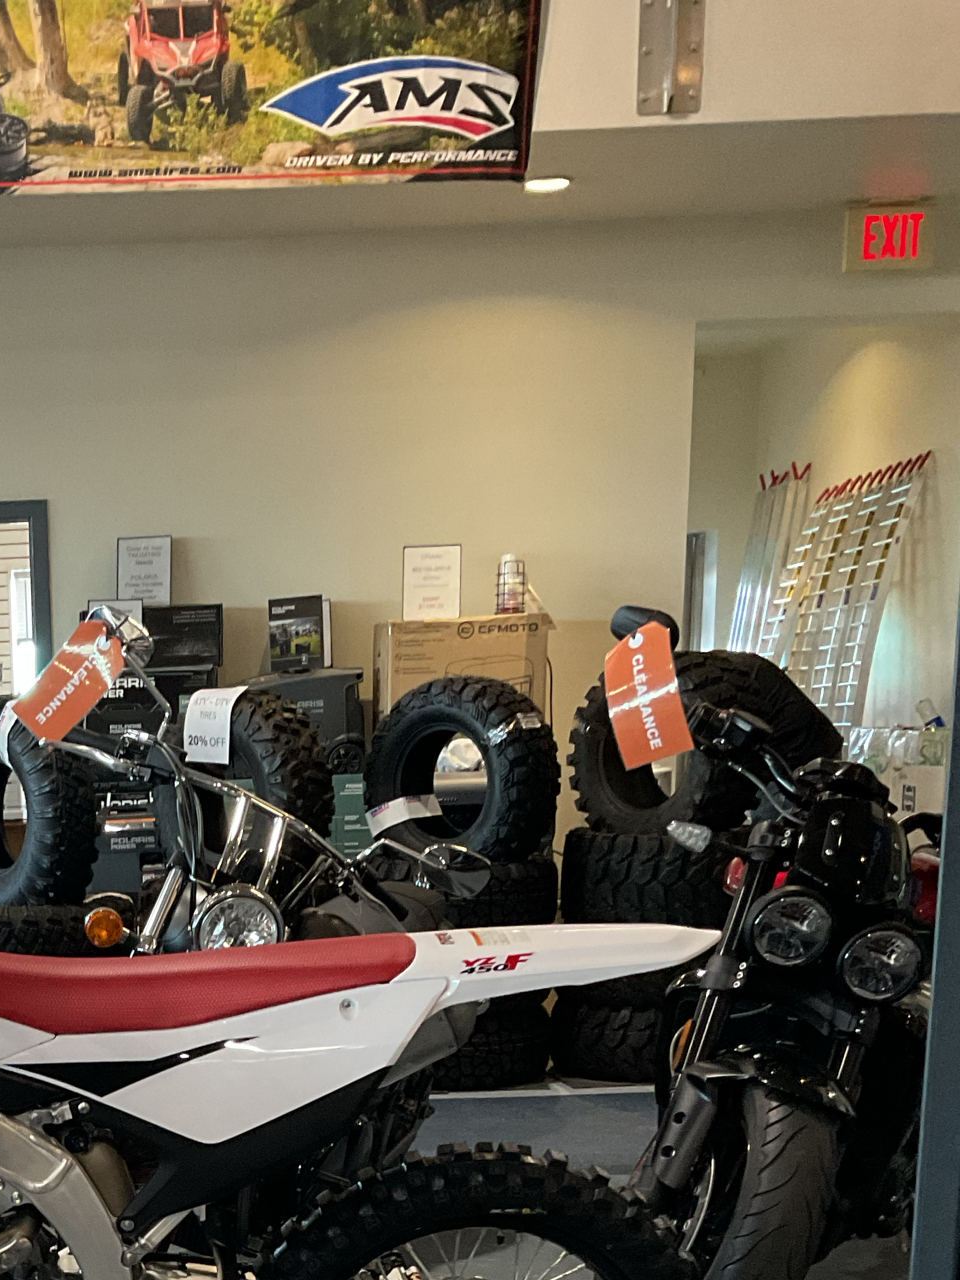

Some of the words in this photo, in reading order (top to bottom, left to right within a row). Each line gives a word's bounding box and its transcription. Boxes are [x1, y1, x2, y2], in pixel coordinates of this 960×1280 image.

[327, 76, 512, 128] AMS
[285, 153, 354, 168] DRIVEN
[357, 152, 384, 165] BY
[387, 149, 518, 164] PERFORMANCE
[68, 165, 243, 179] www.amstires.com
[862, 212, 925, 261] EXIT
[478, 621, 539, 635] CFMOTO
[297, 698, 324, 708] ARIS
[199, 710, 217, 720] TIRES
[188, 735, 208, 747] 20%
[209, 736, 227, 748] OFF
[110, 835, 155, 845] POLARIS
[110, 843, 136, 851] POWER
